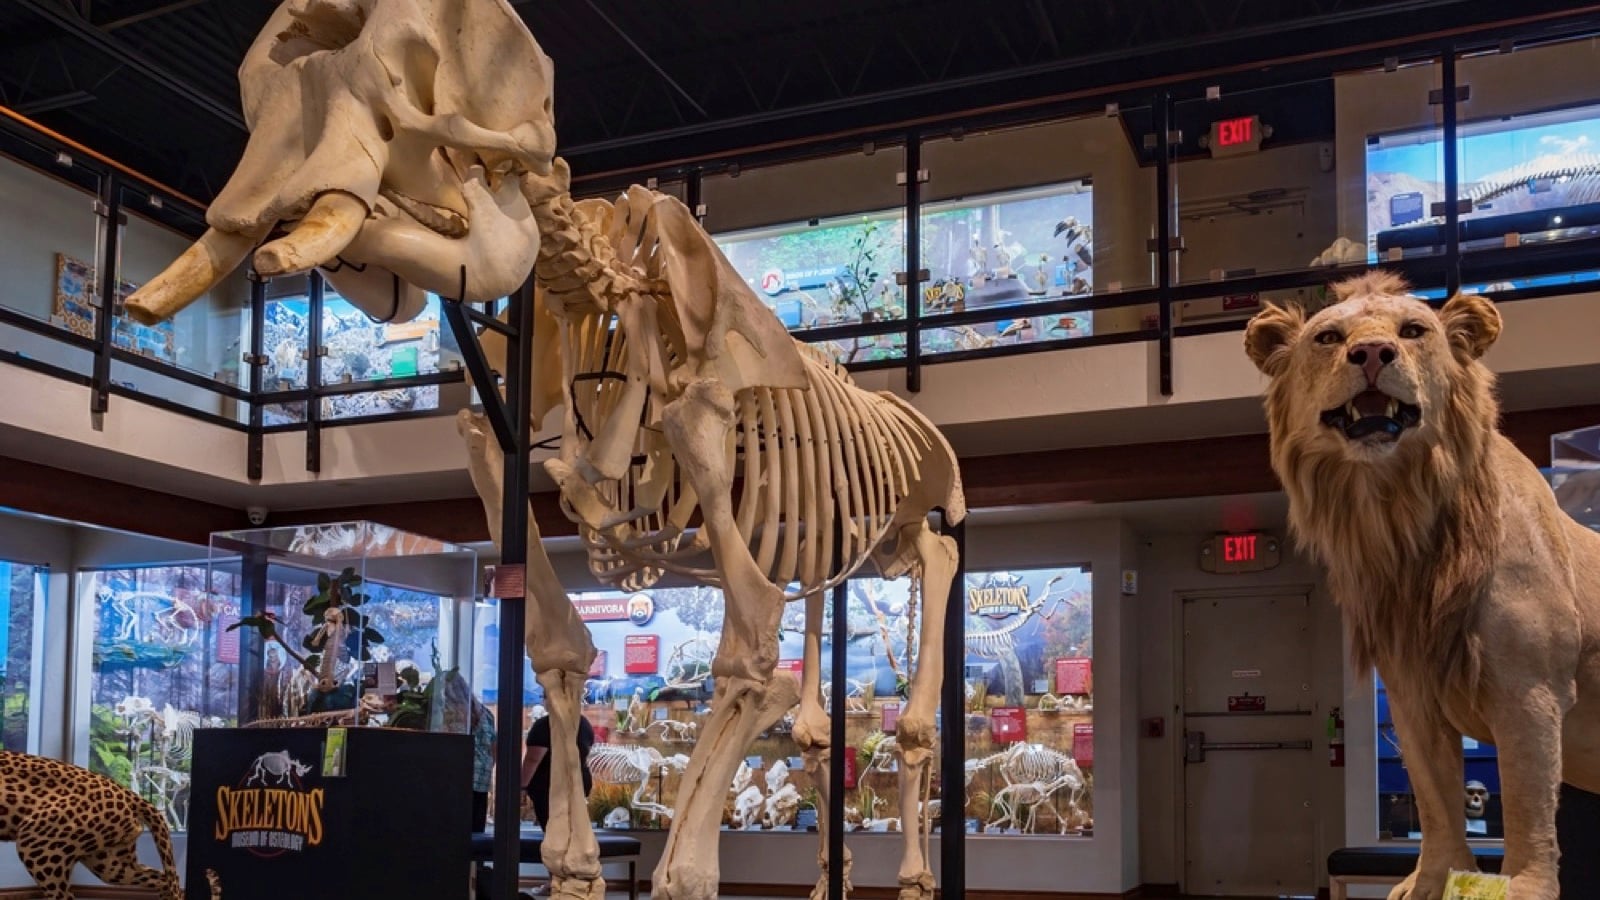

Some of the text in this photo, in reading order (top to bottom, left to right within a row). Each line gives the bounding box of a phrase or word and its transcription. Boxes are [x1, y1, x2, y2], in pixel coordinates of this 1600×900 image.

[1219, 118, 1253, 146] EXIT
[1224, 536, 1257, 561] EXIT
[969, 585, 1029, 613] SKELETONS
[215, 785, 324, 845] SKELETONS
[260, 831, 268, 848] OF
